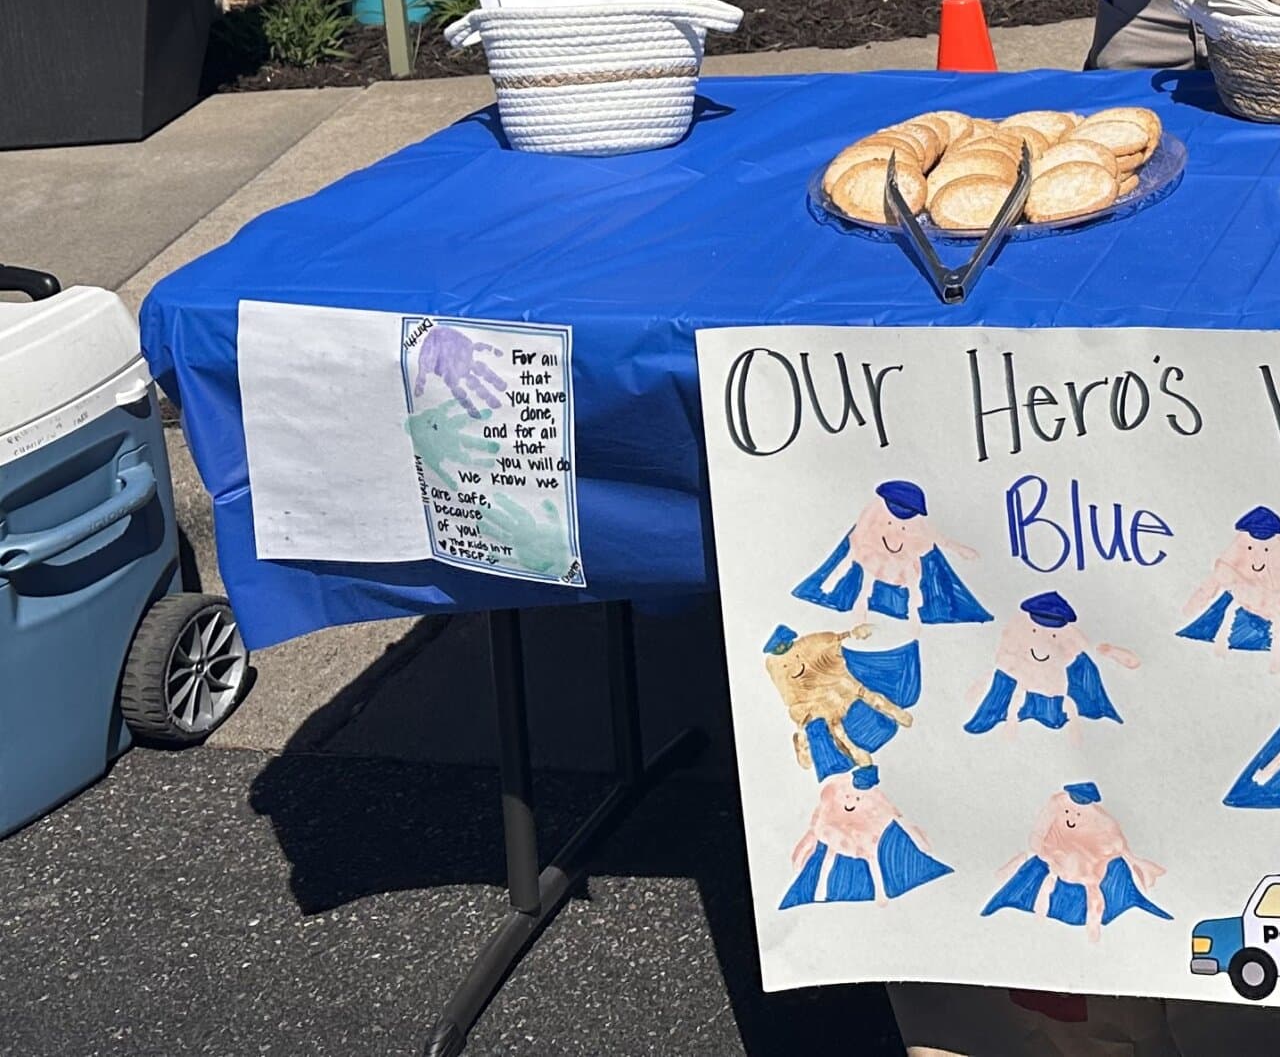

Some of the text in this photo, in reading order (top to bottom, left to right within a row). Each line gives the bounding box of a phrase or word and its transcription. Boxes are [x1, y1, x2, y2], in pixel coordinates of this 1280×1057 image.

[512, 349, 558, 366] For all
[520, 370, 552, 386] that
[506, 388, 567, 407] you have
[725, 348, 903, 456] Our
[966, 348, 1203, 461] Hero's
[520, 406, 555, 425] done,
[483, 424, 557, 439] and for all
[513, 440, 546, 455] that
[496, 457, 572, 472] you will do
[458, 471, 559, 489] We know we
[430, 487, 491, 509] are safe,
[433, 501, 483, 520] because
[438, 519, 482, 538] of you!
[1005, 474, 1175, 574] Blue
[448, 538, 464, 547] The
[458, 548, 484, 560] PSCP
